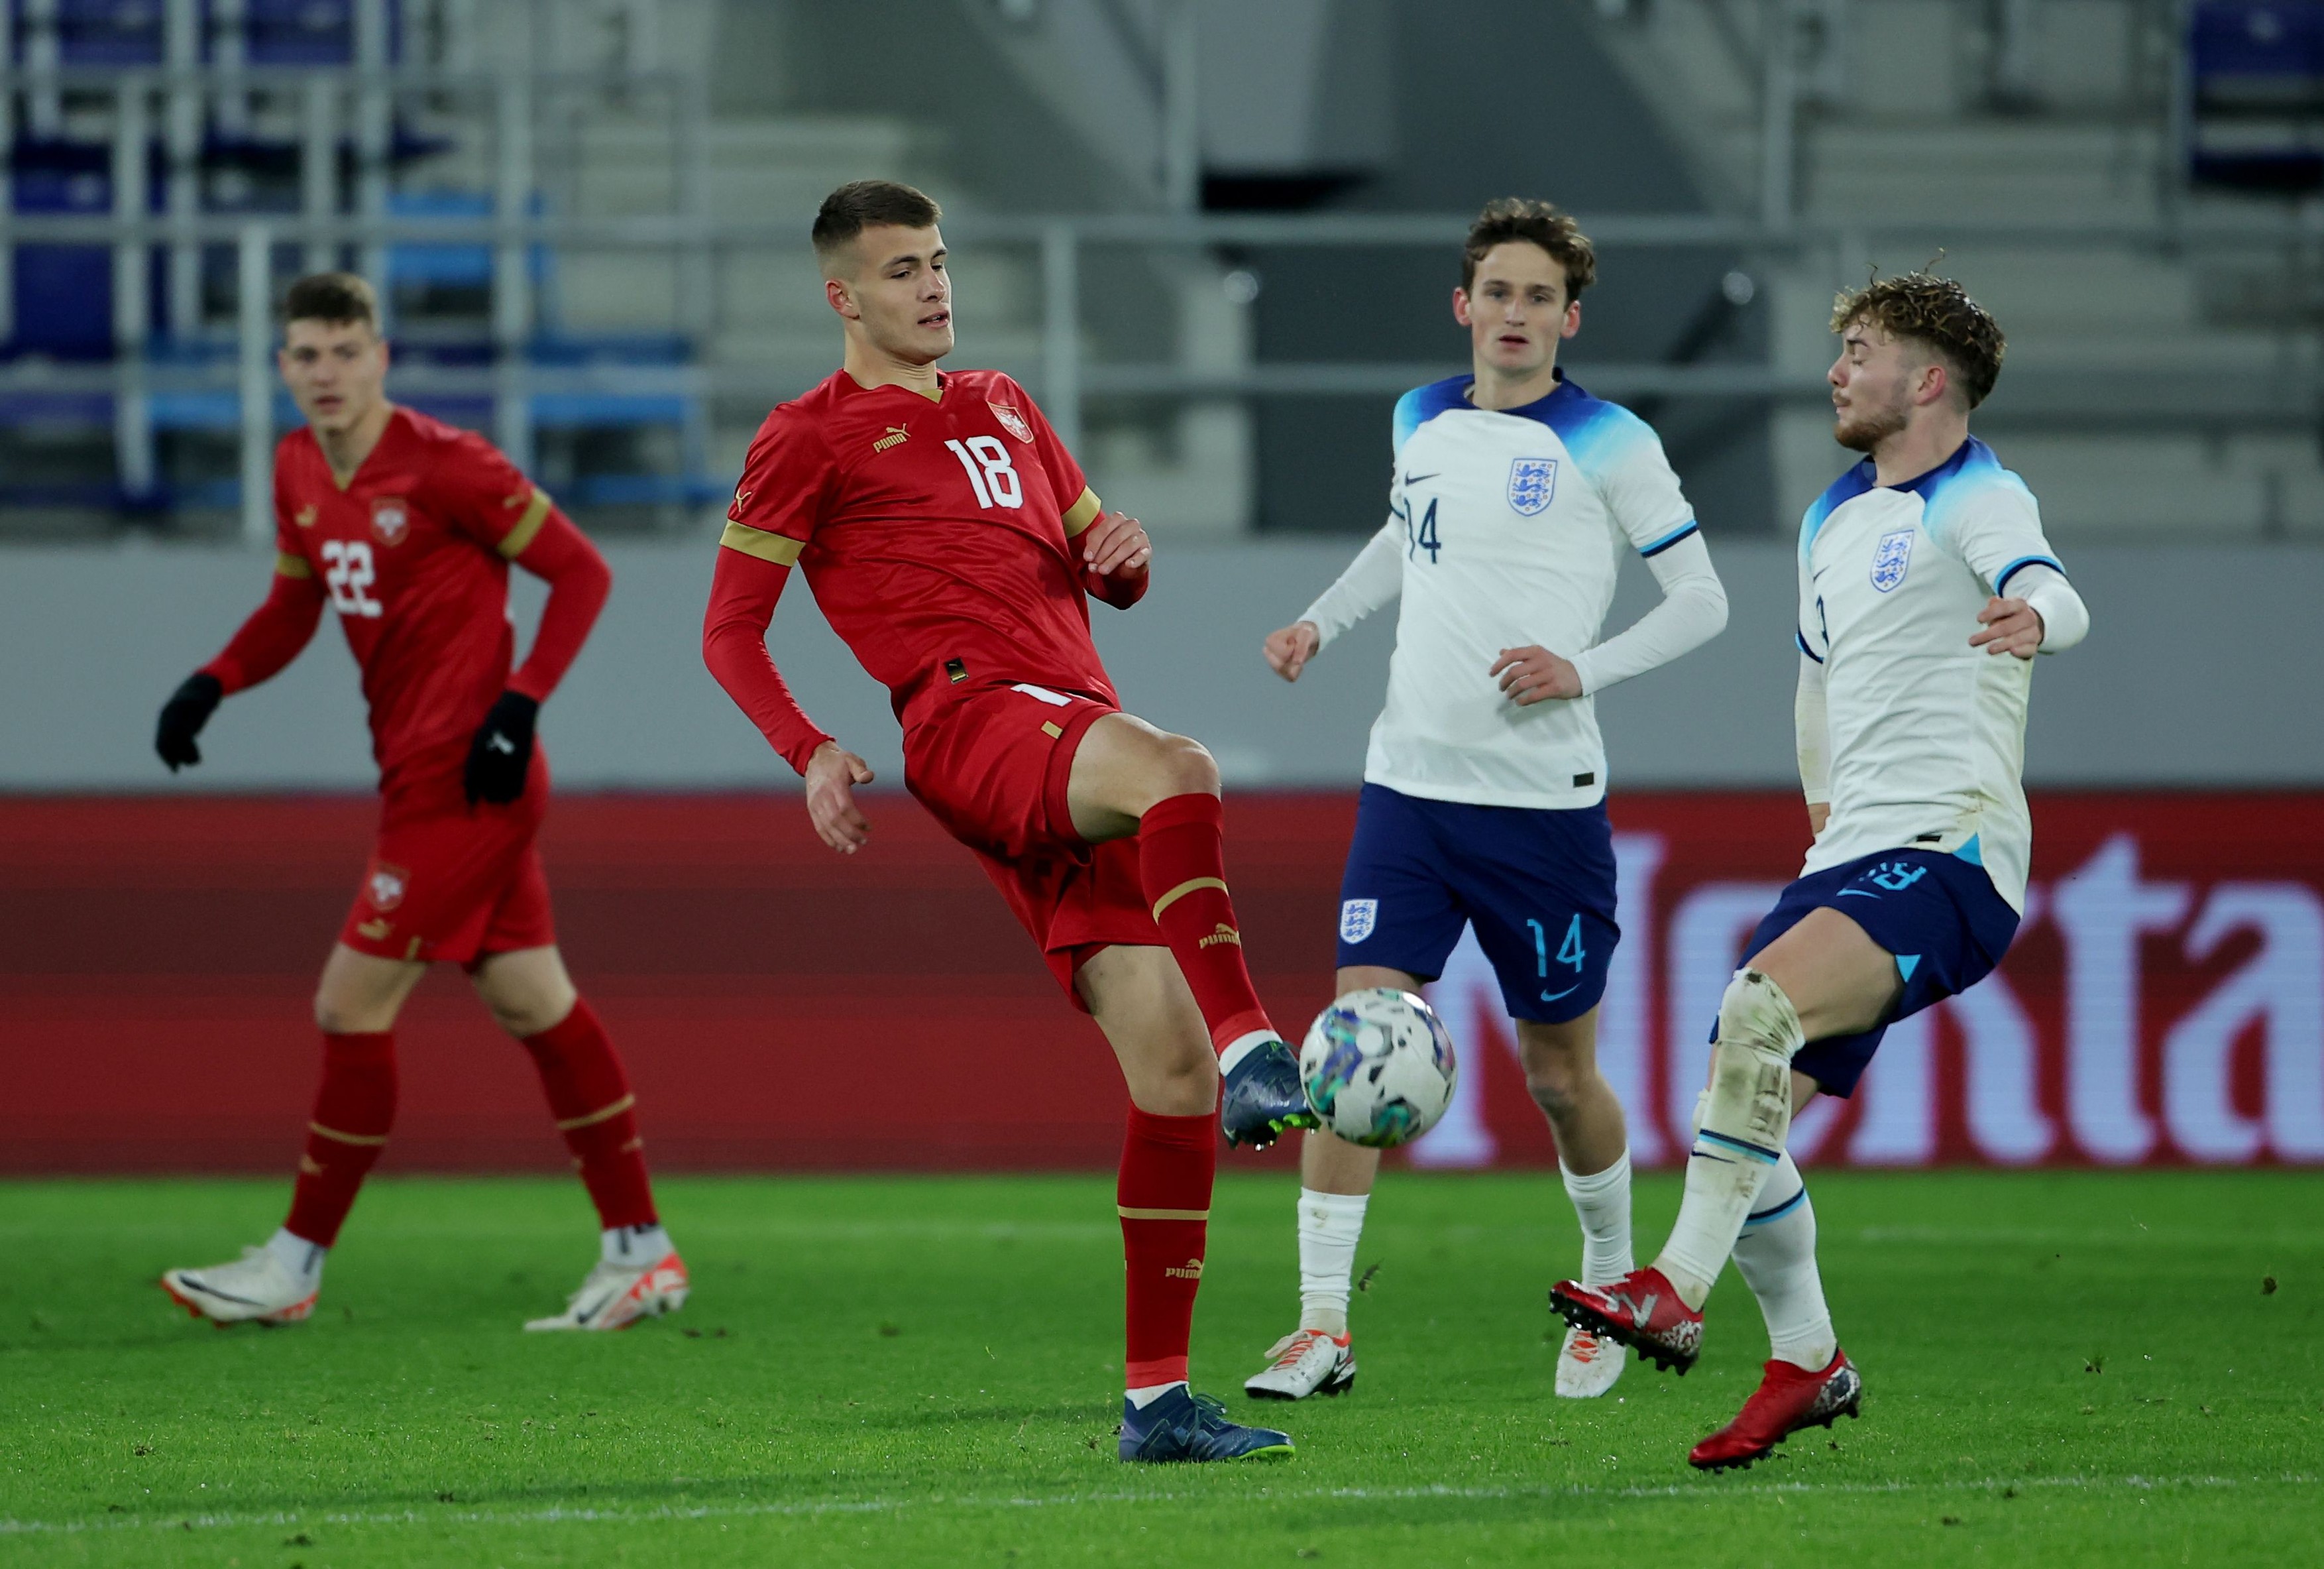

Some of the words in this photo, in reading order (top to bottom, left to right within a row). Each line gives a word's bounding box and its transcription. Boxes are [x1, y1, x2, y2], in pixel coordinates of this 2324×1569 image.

[873, 433, 907, 453] PUMA
[944, 435, 1024, 510] 18
[1403, 497, 1441, 565] 14
[321, 540, 383, 617] 22
[1527, 913, 1586, 977] 14
